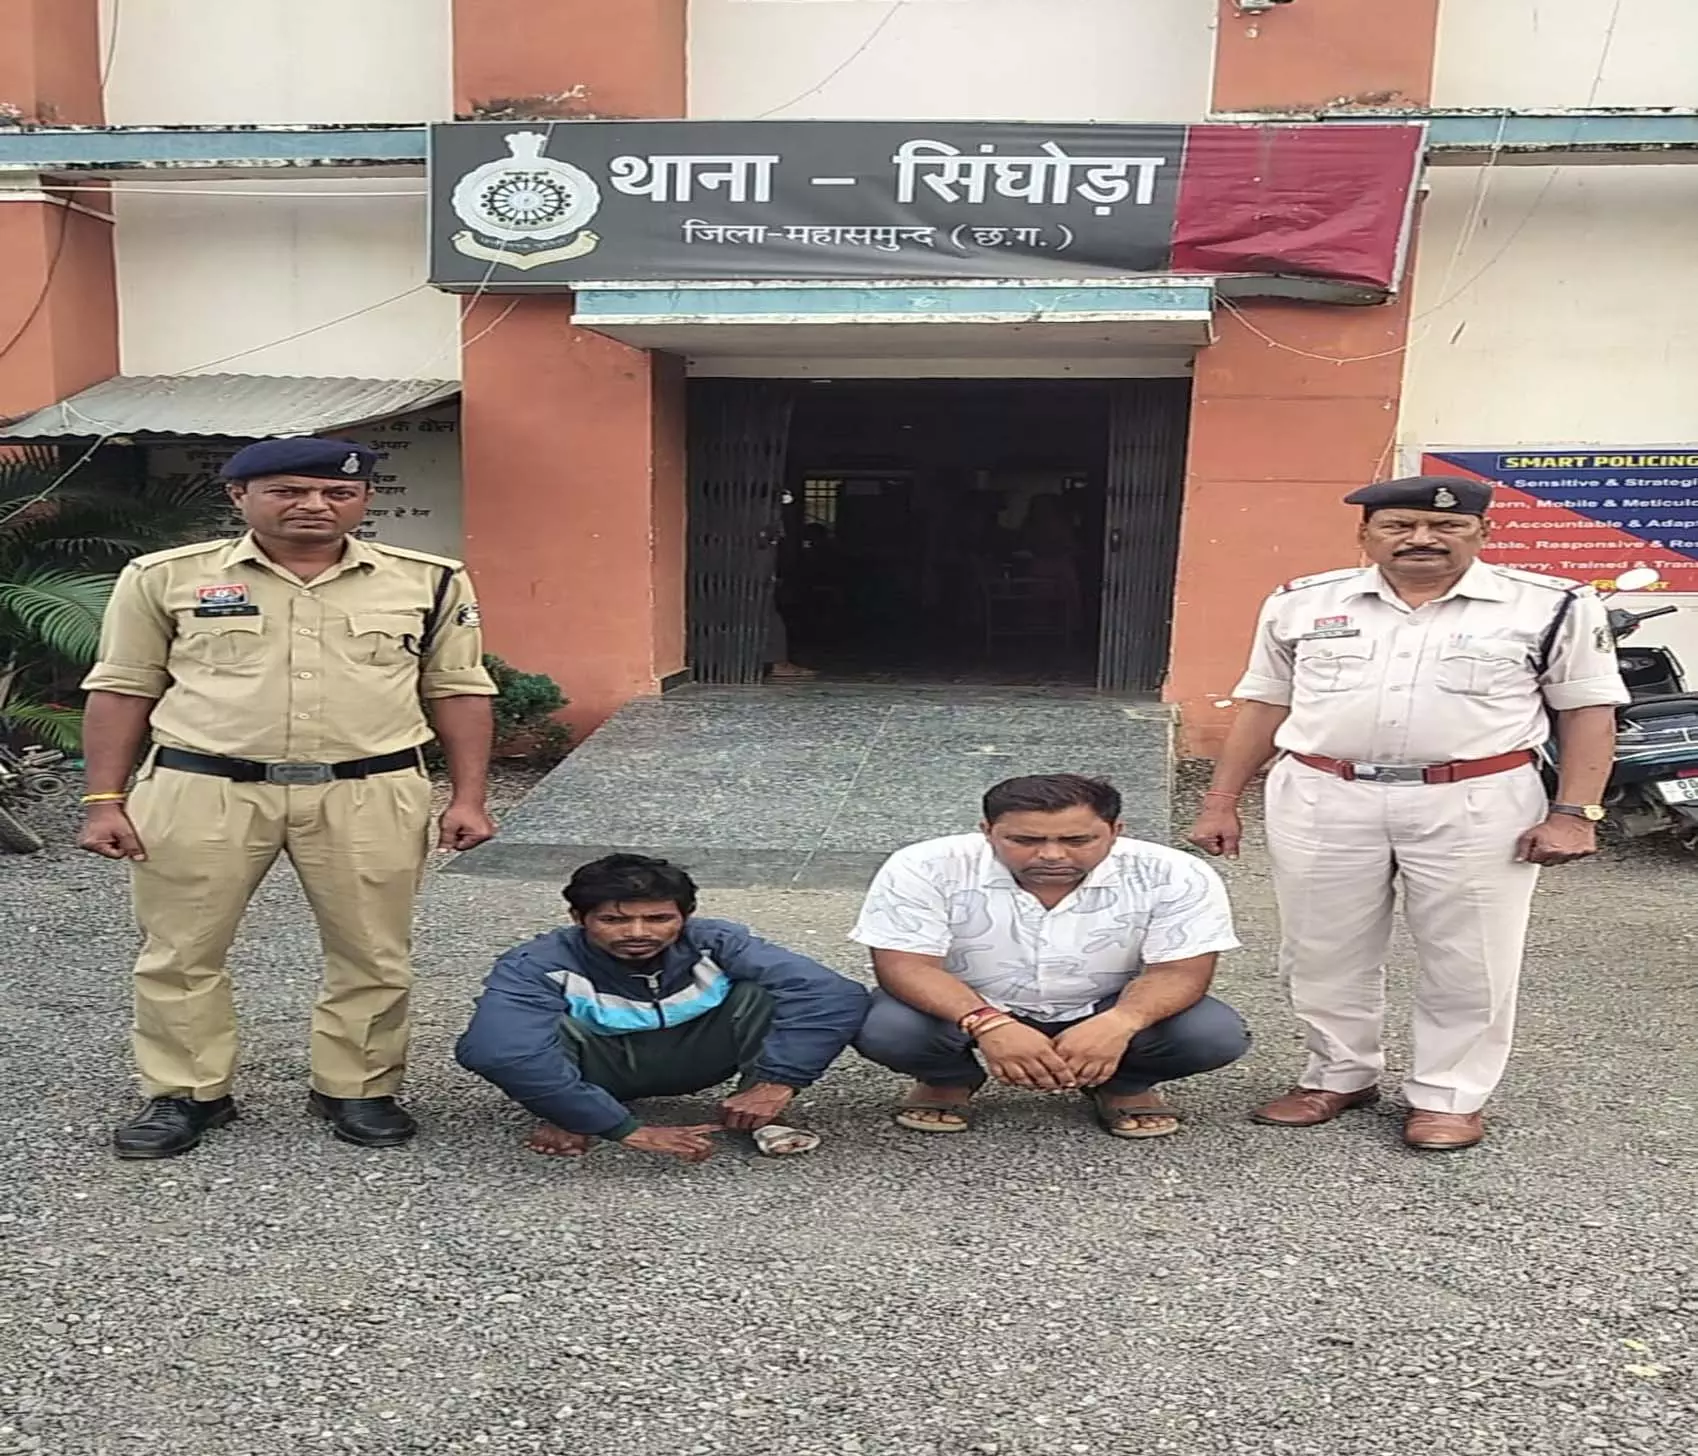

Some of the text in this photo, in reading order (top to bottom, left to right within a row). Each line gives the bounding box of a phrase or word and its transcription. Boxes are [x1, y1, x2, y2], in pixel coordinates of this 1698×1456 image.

[610, 155, 779, 202] थाना
[892, 139, 1166, 216] सिंघोड़ा
[682, 219, 937, 250] जिला-महासमुन्द
[1505, 455, 1698, 468] SMART POLICING
[1514, 478, 1600, 488] Sensitive
[1605, 478, 1619, 487] &
[1536, 499, 1597, 508] Mobile
[1603, 499, 1618, 508] &
[1506, 519, 1623, 529] Accountable
[1628, 519, 1642, 528] &
[1536, 540, 1645, 550] Responsive
[1650, 540, 1664, 549] &
[1560, 560, 1628, 569] Trained
